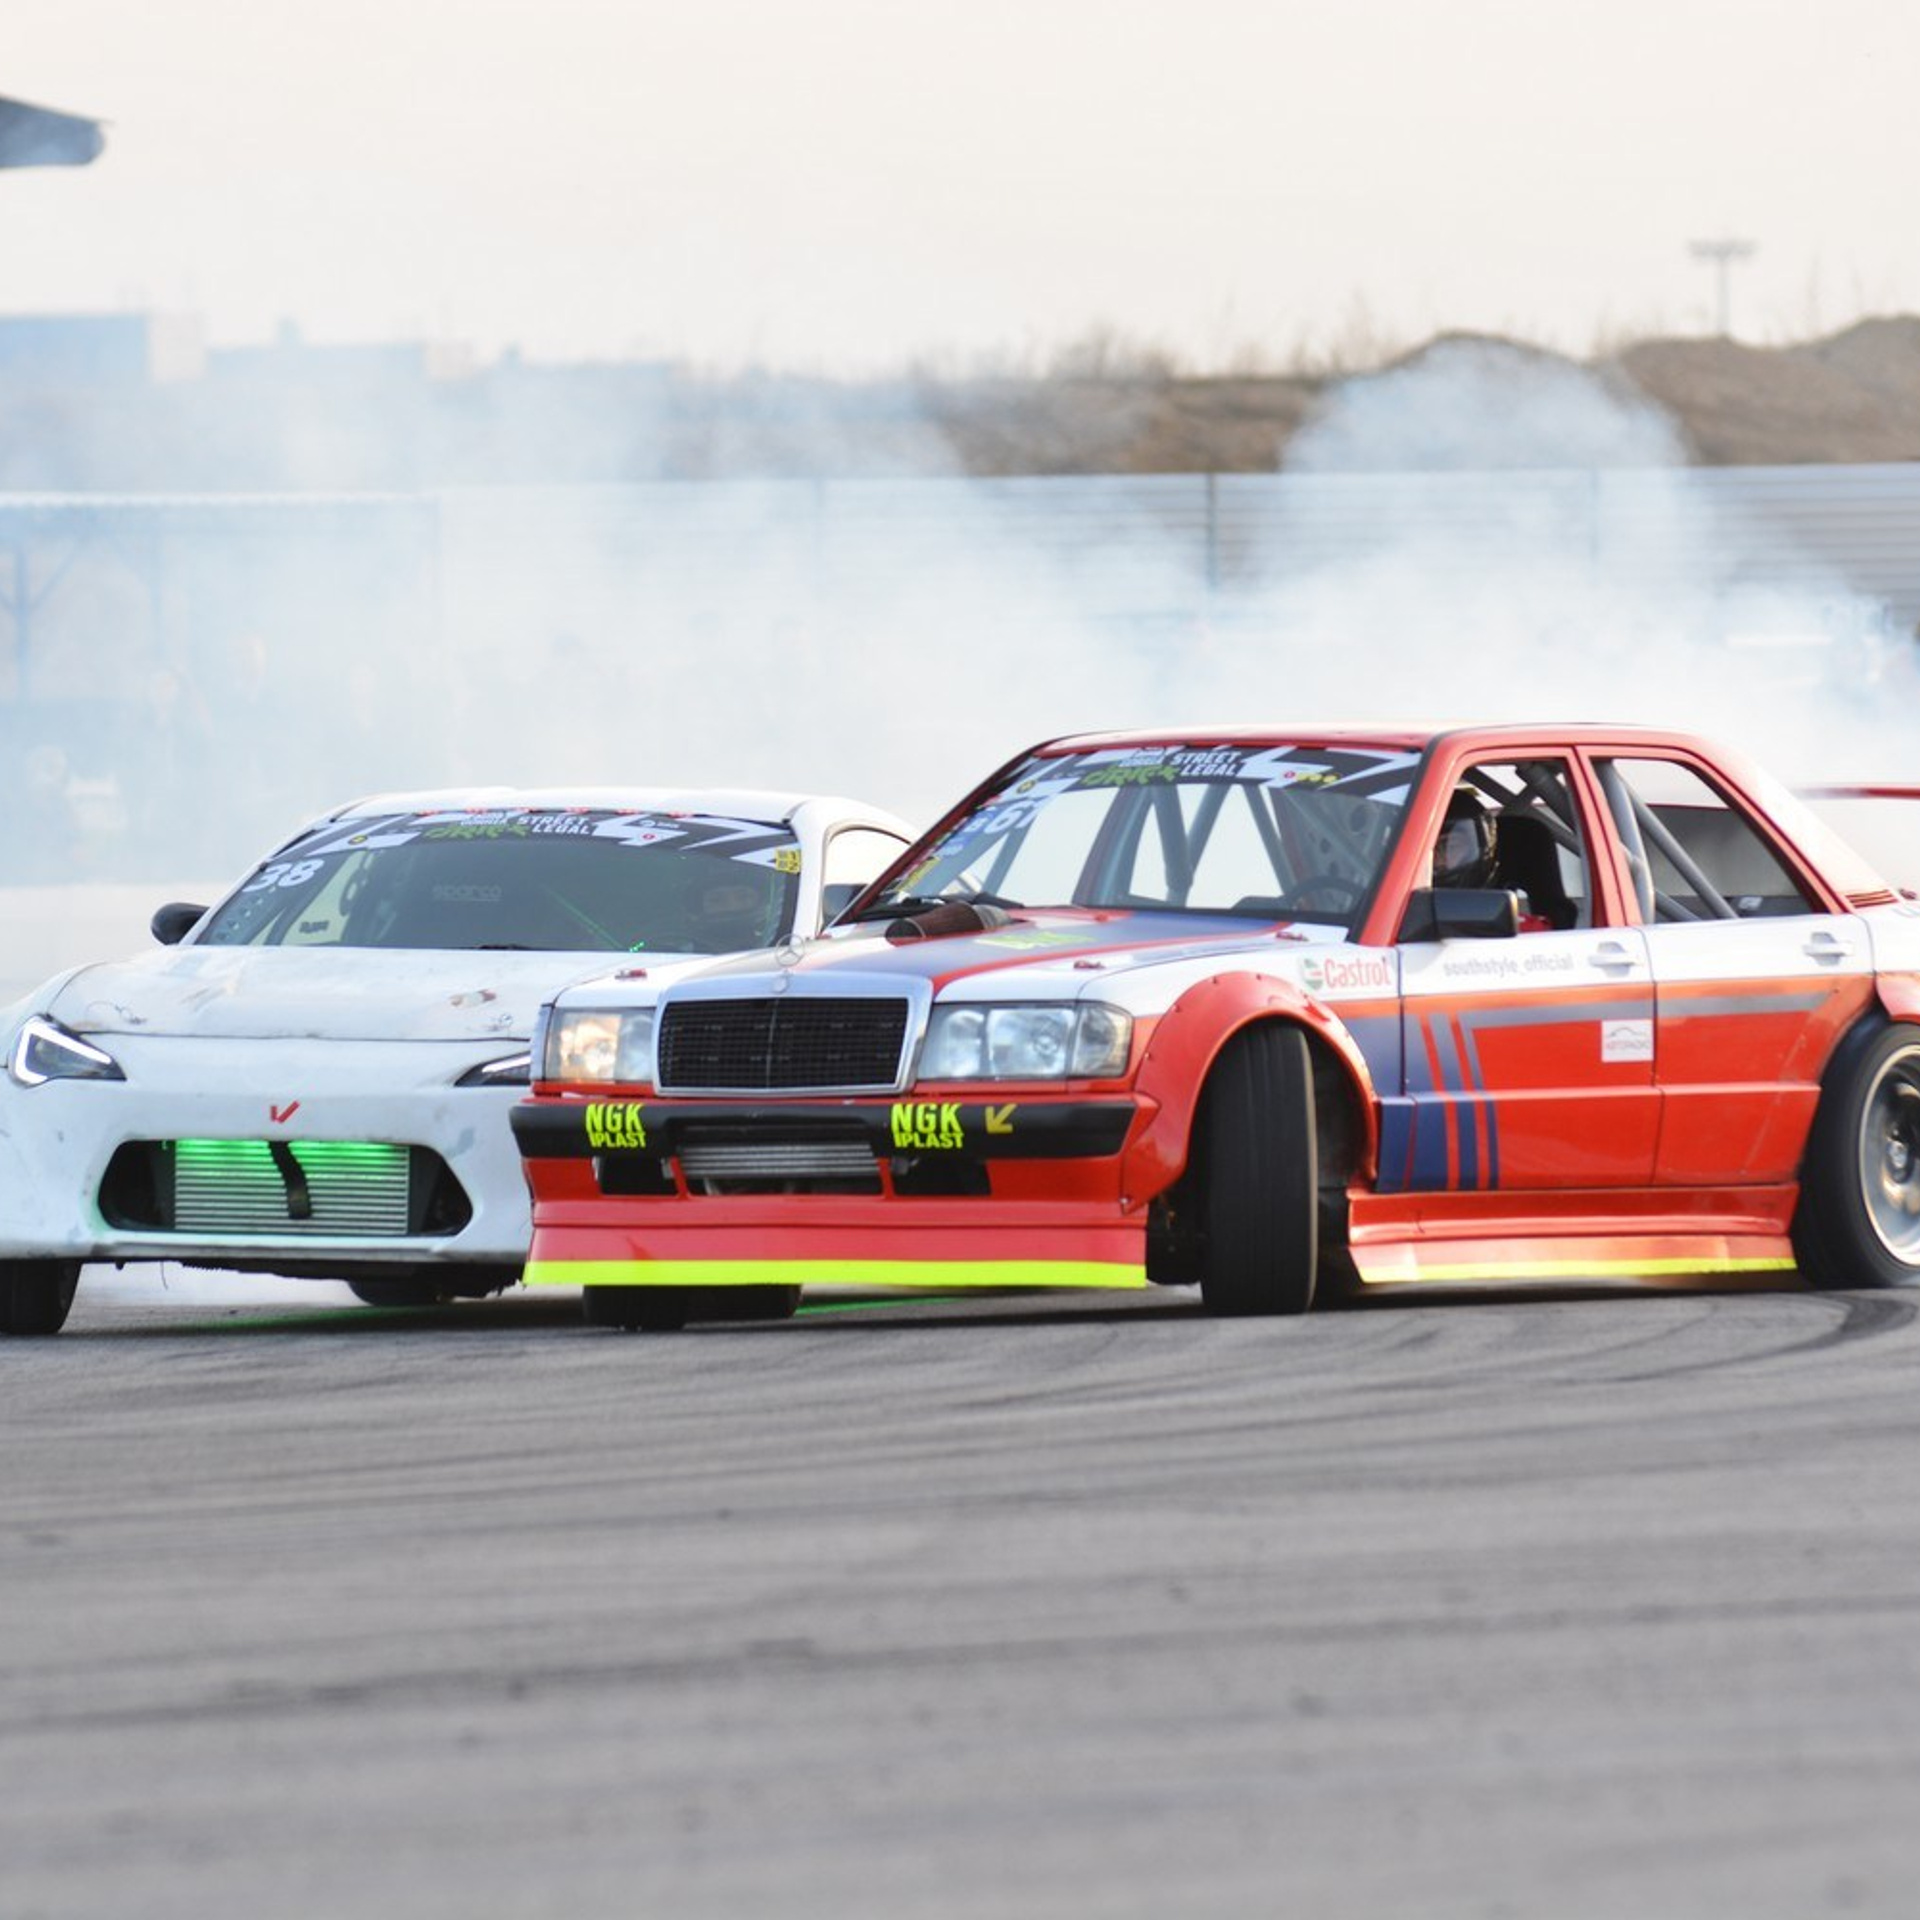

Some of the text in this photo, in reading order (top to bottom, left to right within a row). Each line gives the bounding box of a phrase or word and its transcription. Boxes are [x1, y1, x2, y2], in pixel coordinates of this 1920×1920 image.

[1169, 752, 1242, 765] STREET
[1180, 763, 1238, 776] LEGAL
[516, 815, 590, 826] STREET
[532, 825, 590, 835] LEGAL
[242, 858, 325, 892] 38
[1324, 957, 1392, 988] Castrol
[586, 1103, 645, 1133] NGK
[891, 1103, 963, 1133] NGK
